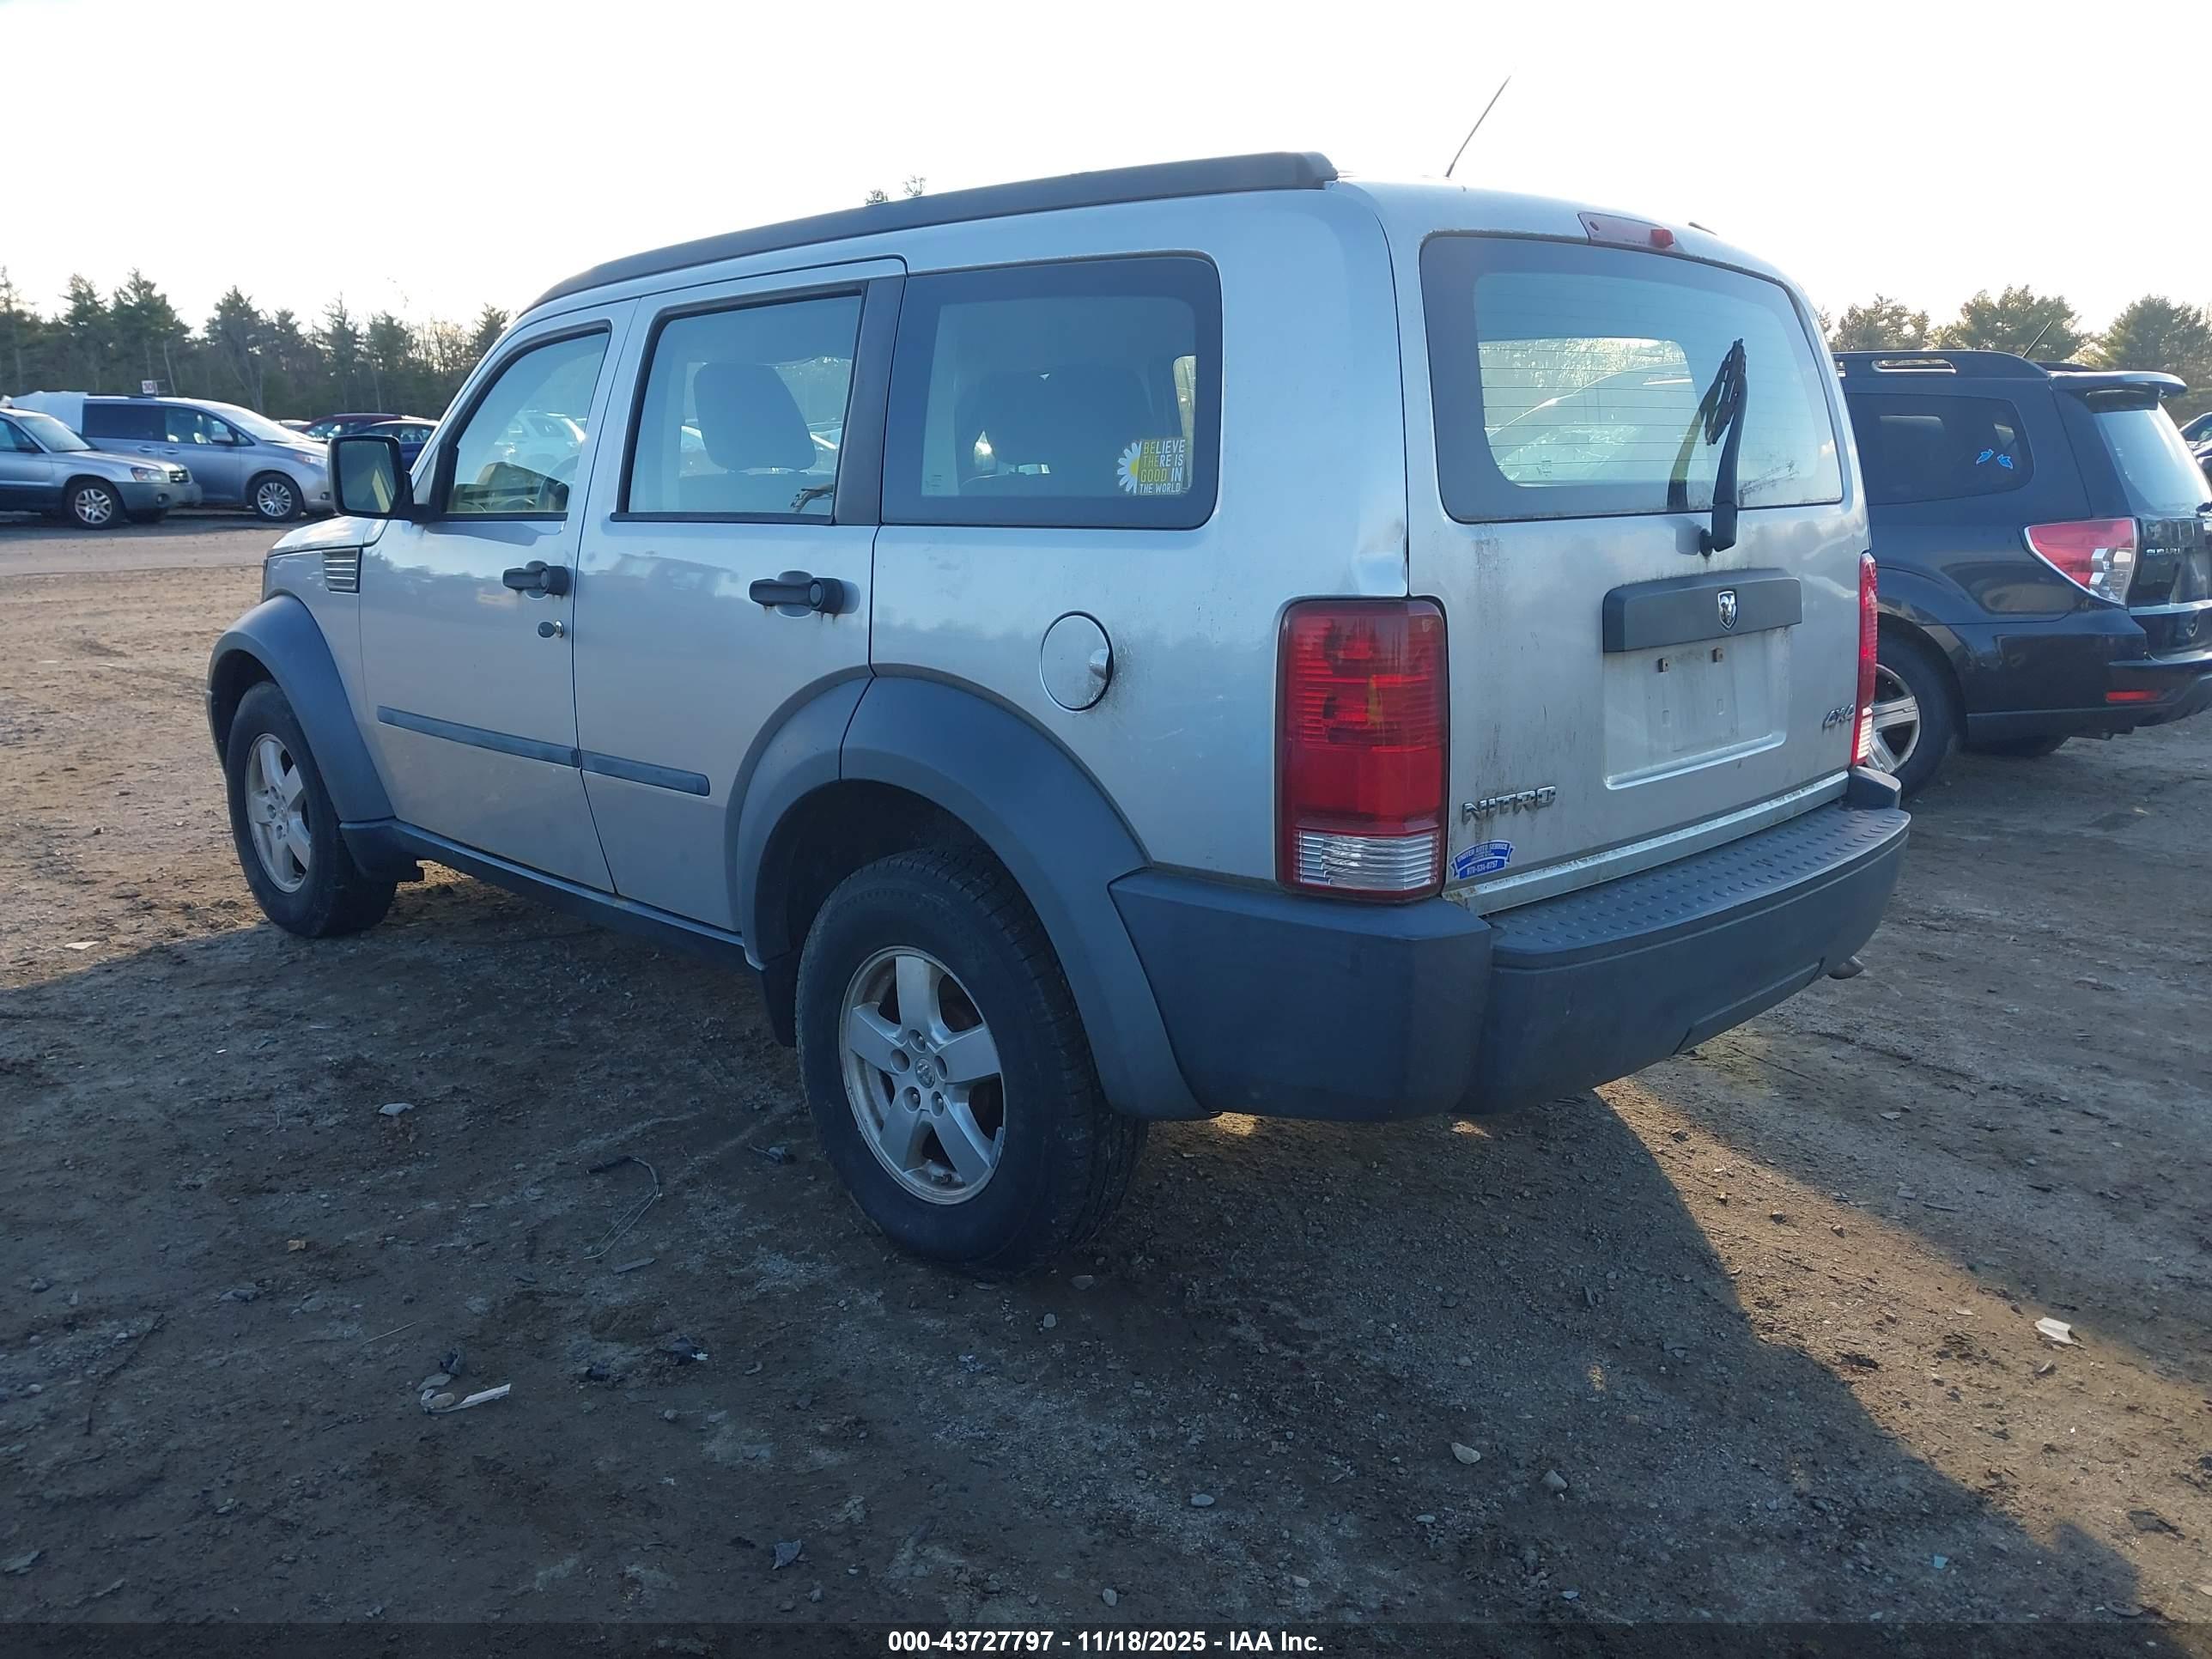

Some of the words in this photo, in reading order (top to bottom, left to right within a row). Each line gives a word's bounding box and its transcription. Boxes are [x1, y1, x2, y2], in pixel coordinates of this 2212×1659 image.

[1144, 439, 1186, 454] BELIEVE
[1143, 454, 1172, 468] THERE
[1175, 454, 1184, 466] IS
[1140, 468, 1167, 482] GOOD
[1170, 467, 1182, 482] IN
[1139, 483, 1152, 494] THE
[1155, 483, 1181, 494] WORLD
[1462, 786, 1557, 825] NITRO
